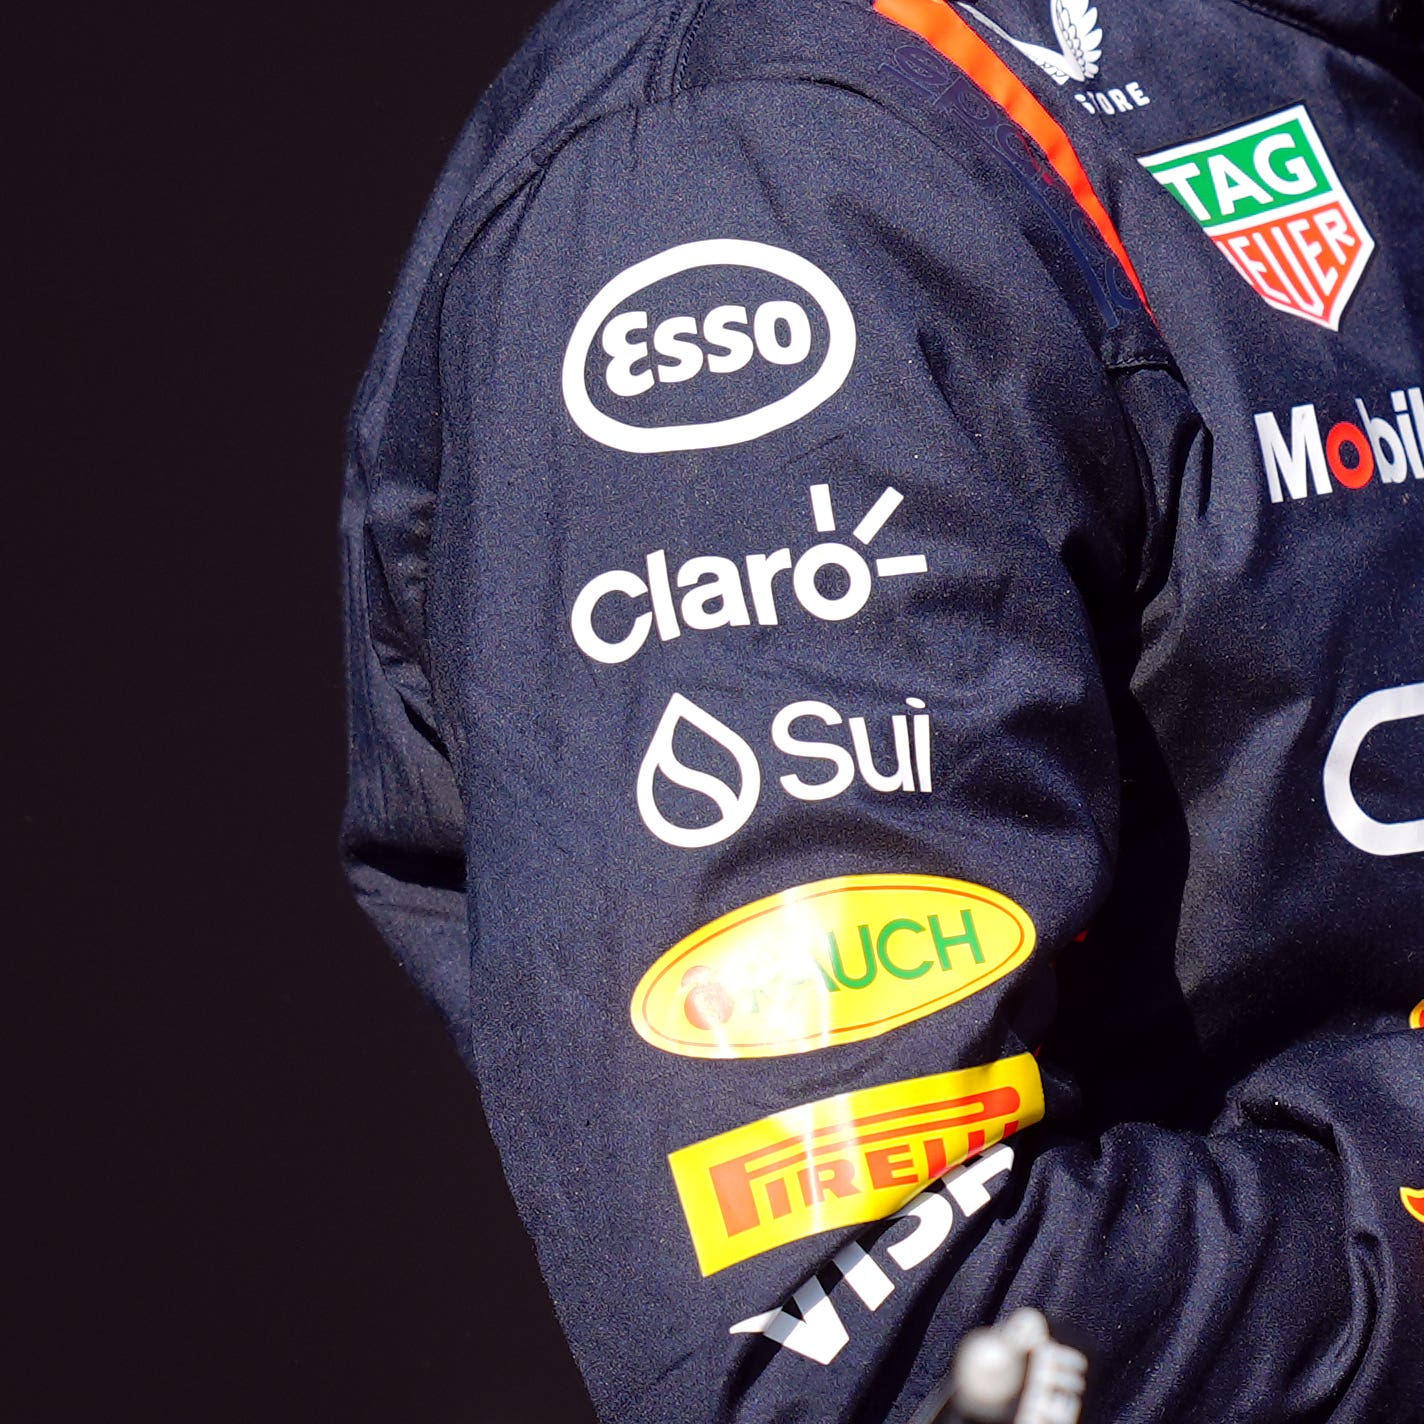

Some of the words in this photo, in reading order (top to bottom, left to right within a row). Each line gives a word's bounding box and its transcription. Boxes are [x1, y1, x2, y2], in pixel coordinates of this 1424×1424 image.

[1151, 132, 1318, 222] TAG
[1216, 207, 1356, 317] EUER
[770, 696, 933, 801] Sui
[815, 909, 986, 992] UCH
